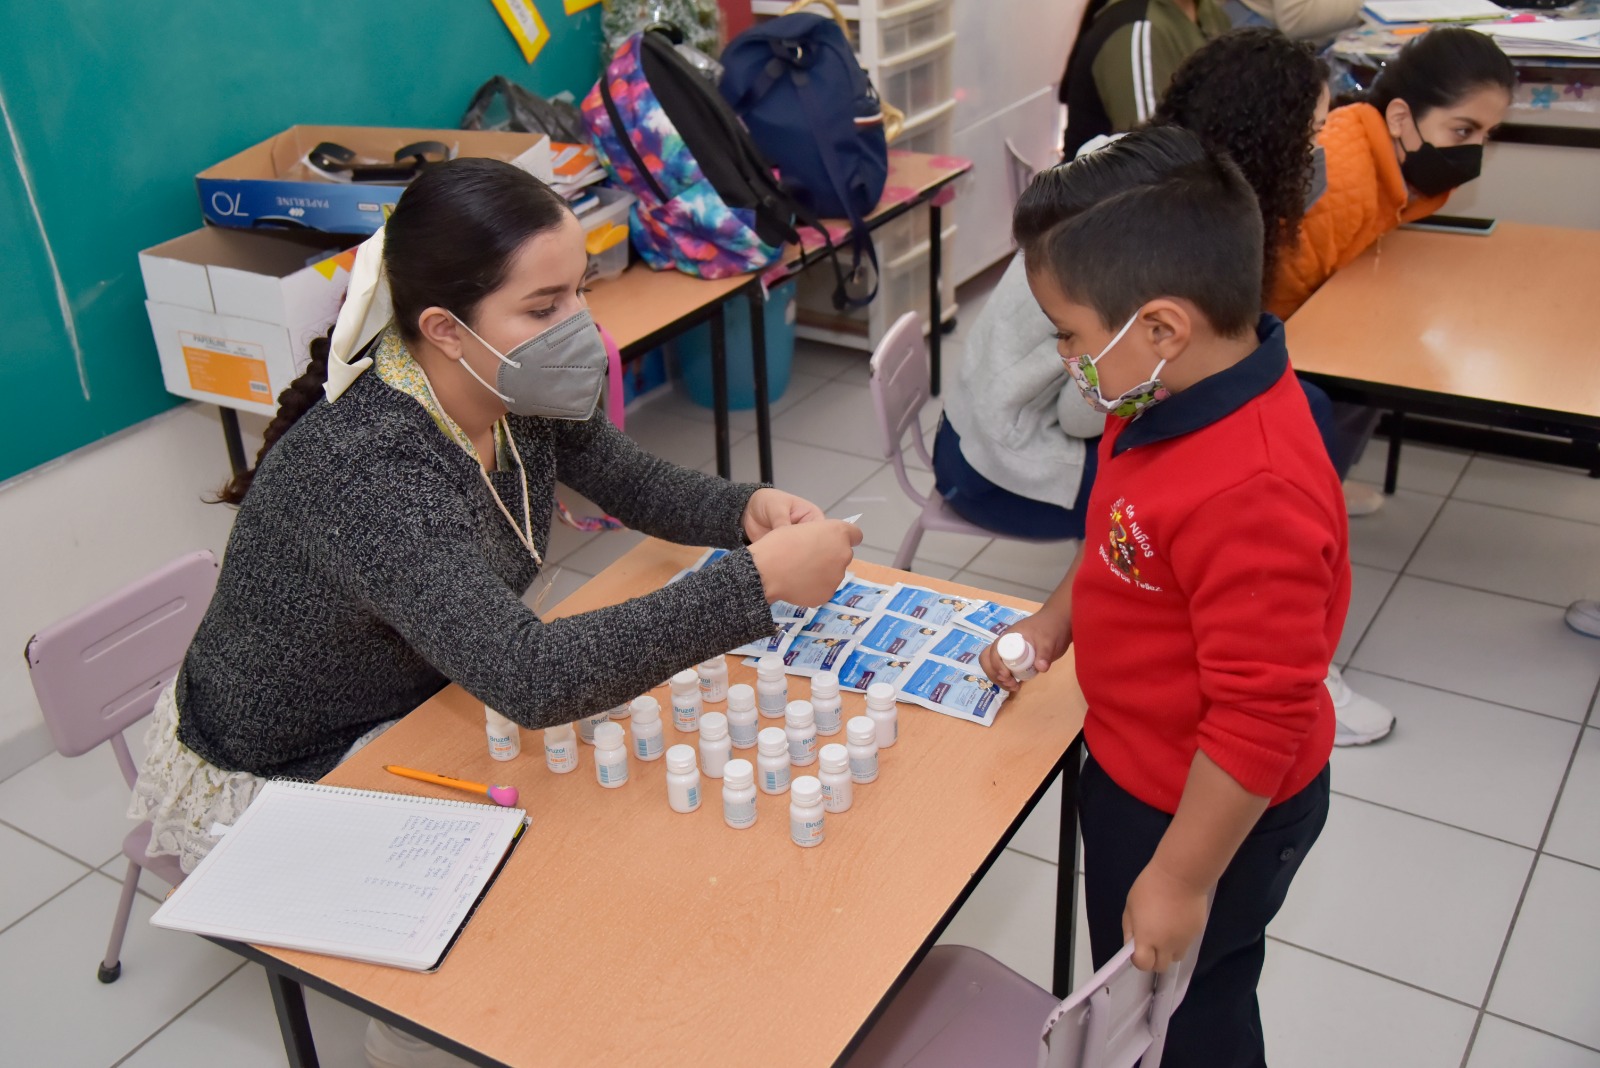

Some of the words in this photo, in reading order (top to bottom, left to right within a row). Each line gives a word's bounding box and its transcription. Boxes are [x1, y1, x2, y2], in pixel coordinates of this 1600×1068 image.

[211, 191, 250, 216] 70
[276, 196, 330, 208] PAPERLINE
[674, 706, 695, 714] Bruzol
[489, 735, 511, 743] Bruzol
[545, 745, 566, 754] Bruzol
